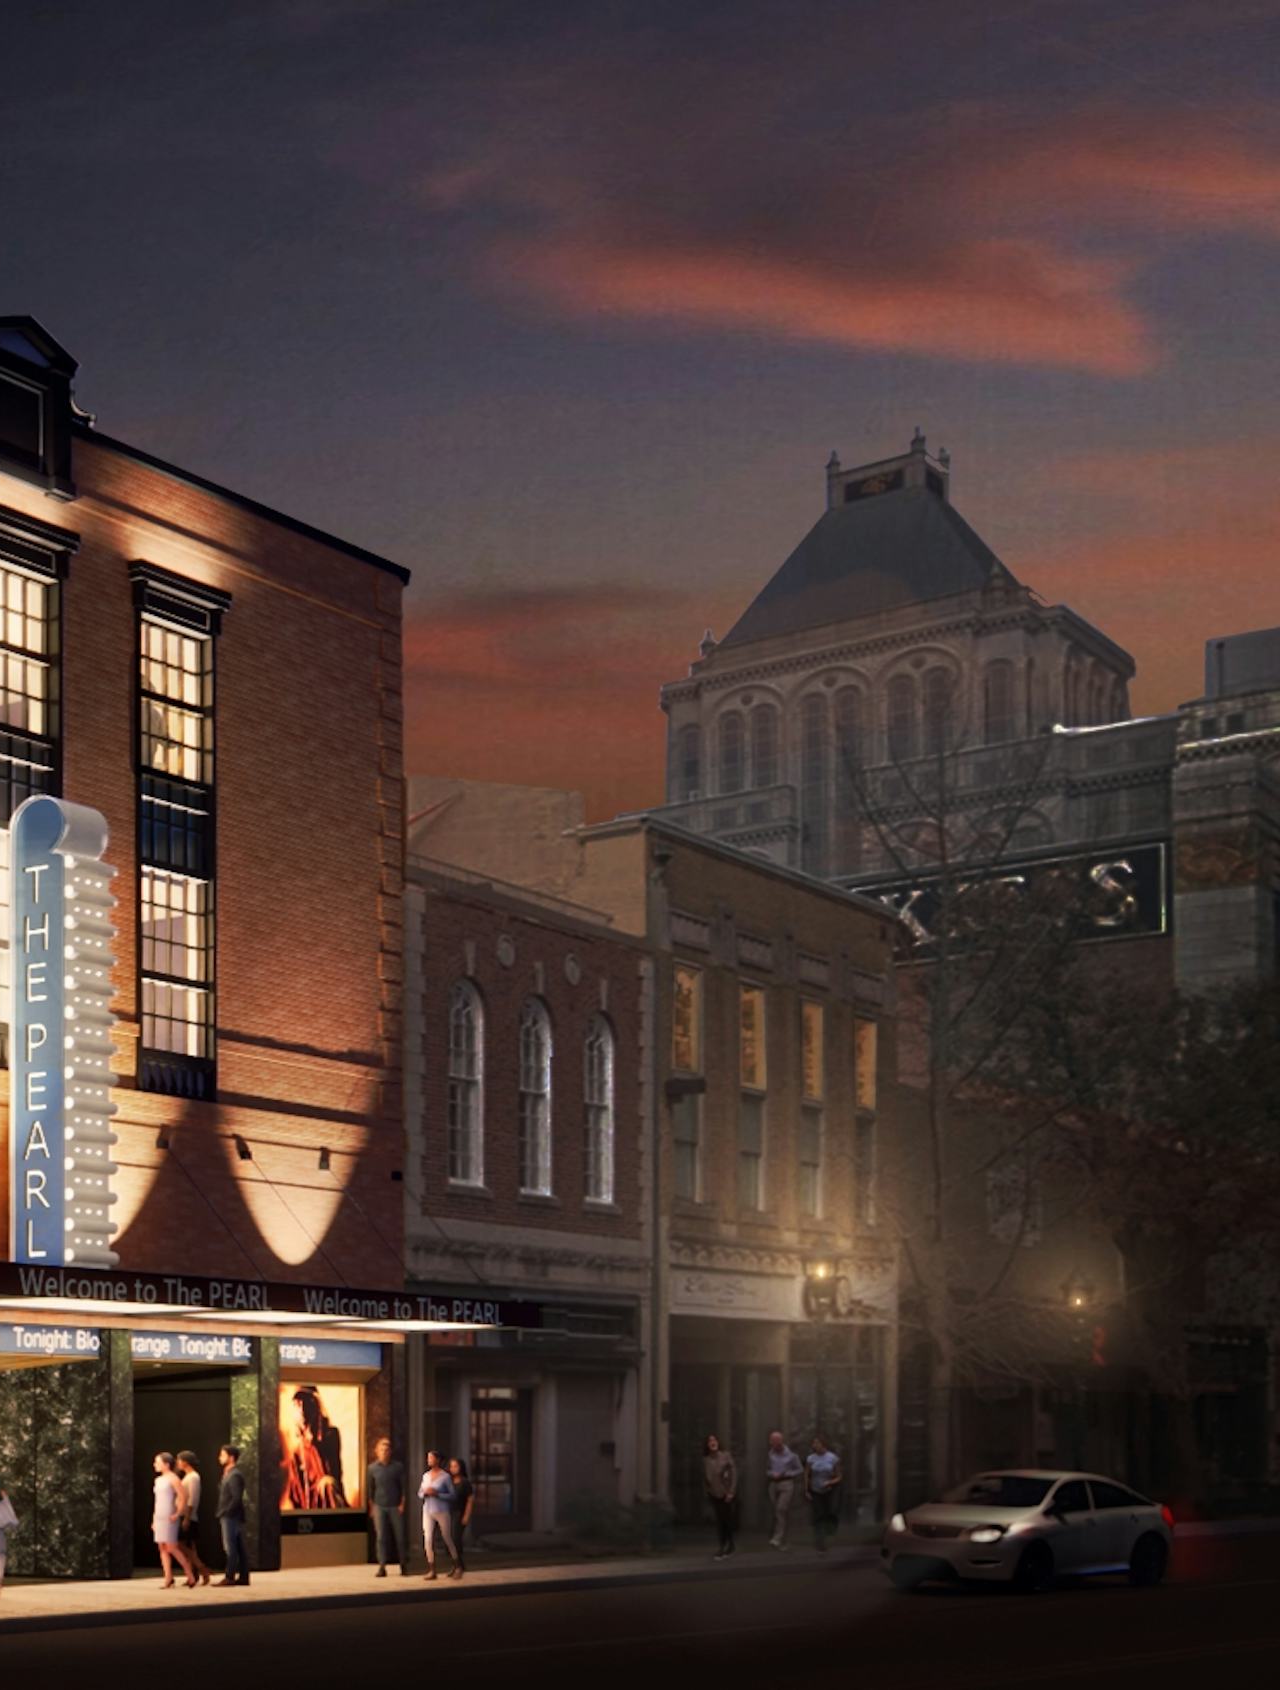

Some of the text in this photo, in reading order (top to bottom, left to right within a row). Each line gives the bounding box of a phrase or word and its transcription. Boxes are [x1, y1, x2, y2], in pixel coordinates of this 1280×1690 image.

[23, 864, 51, 1258] THE PEARL
[20, 1267, 272, 1312] Welcome to The PEARL
[303, 1288, 503, 1326] Welcome to The PEARL
